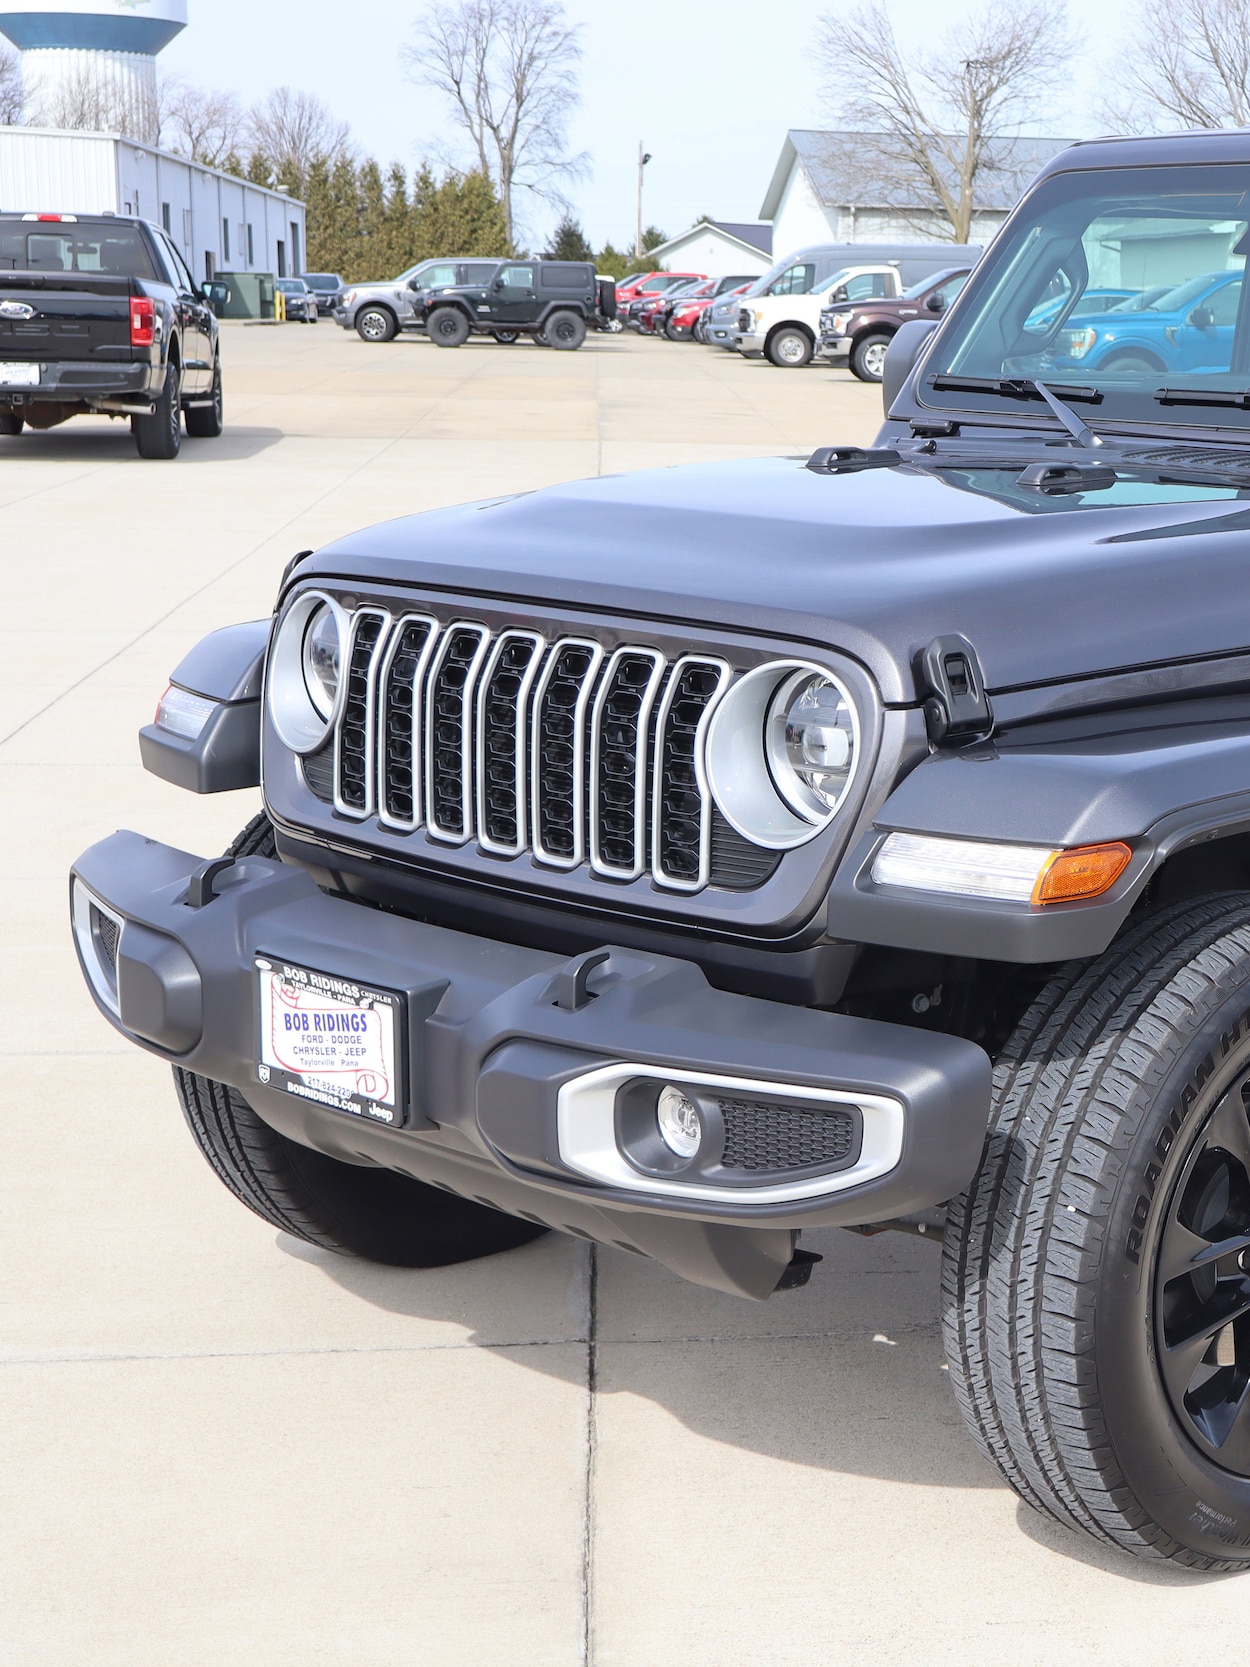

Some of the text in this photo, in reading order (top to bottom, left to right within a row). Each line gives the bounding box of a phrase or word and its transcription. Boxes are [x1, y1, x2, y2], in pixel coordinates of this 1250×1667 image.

[283, 966, 360, 998] BOB RIDINGS
[291, 980, 332, 998] TAYLORVILLE
[337, 994, 356, 1005] PANA
[284, 1013, 367, 1032] BOB RIDINGS
[301, 1034, 324, 1044] FORD
[331, 1035, 362, 1045] DODGE
[293, 1046, 337, 1056] CHRYSLER
[345, 1047, 367, 1056] JEEP
[300, 1058, 359, 1068] Taylorville Pana
[287, 1081, 361, 1115] BOBRIDINGS.COM
[368, 1103, 394, 1123] Jeep
[1123, 1056, 1216, 1265] ROADIAN
